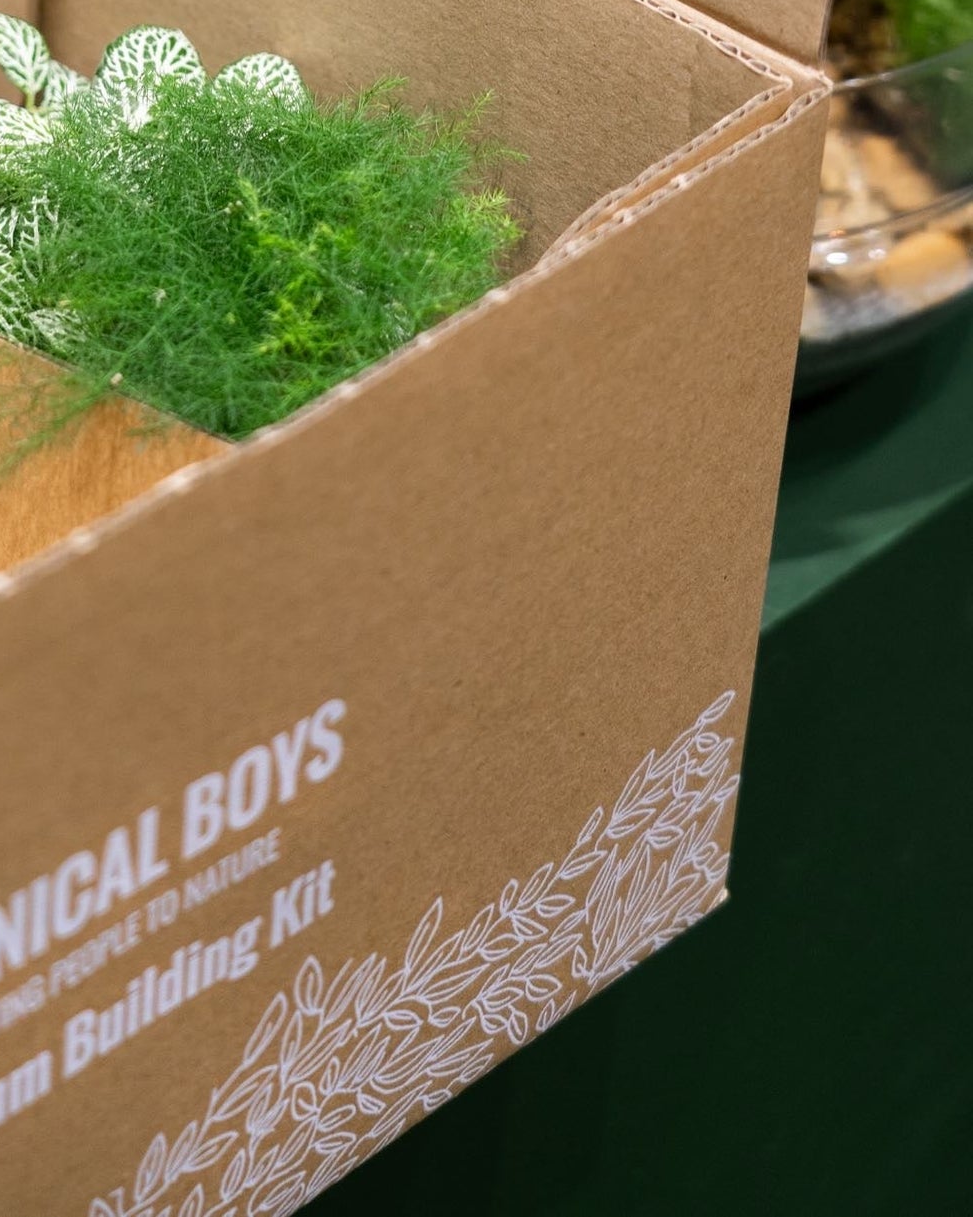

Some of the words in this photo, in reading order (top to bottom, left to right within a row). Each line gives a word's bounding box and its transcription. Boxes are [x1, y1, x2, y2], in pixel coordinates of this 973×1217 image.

[181, 698, 347, 860] BOYS
[48, 909, 141, 997] PEOPLE
[146, 887, 179, 933] TO
[182, 826, 281, 910] NATURE
[61, 915, 263, 1080] Building
[269, 859, 336, 950] Kit
